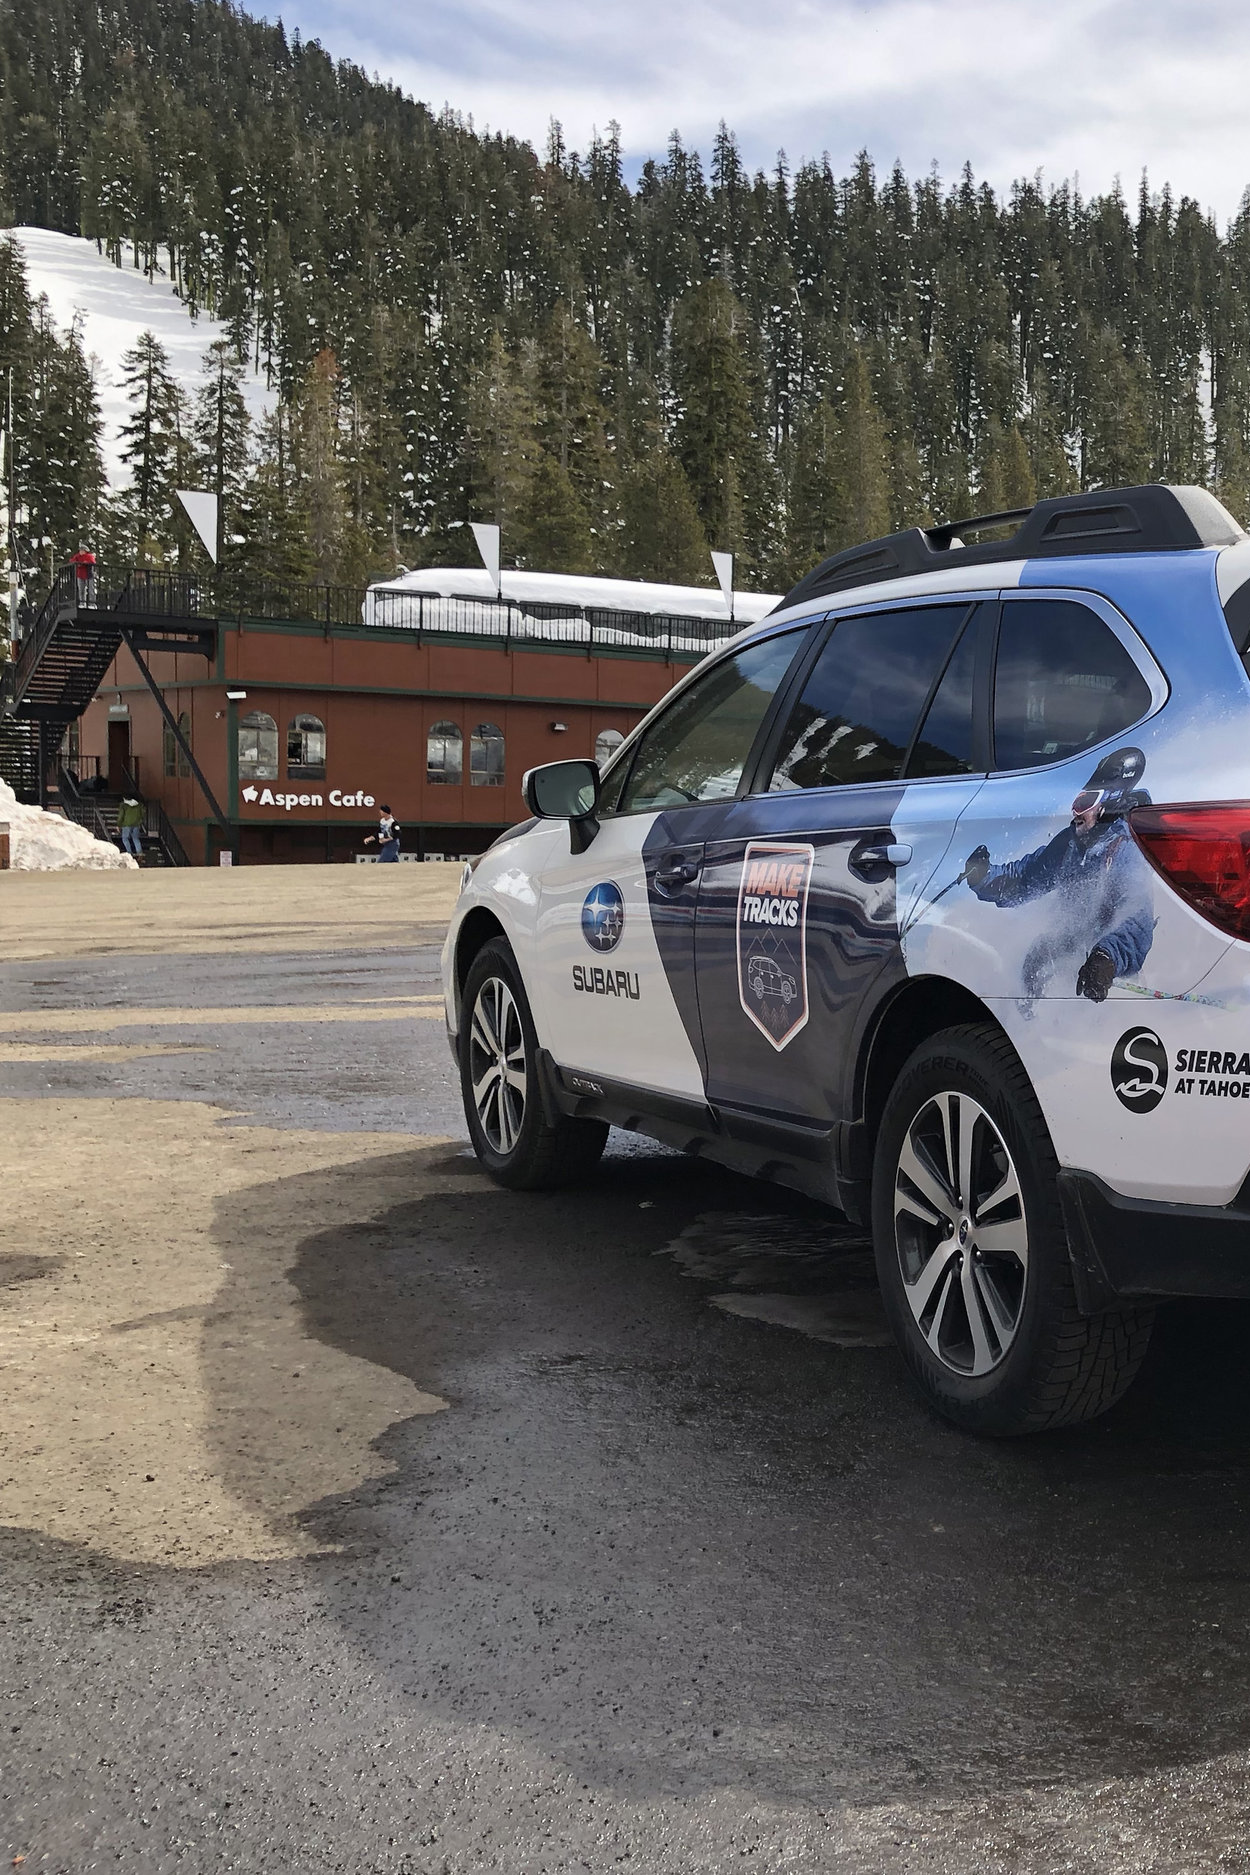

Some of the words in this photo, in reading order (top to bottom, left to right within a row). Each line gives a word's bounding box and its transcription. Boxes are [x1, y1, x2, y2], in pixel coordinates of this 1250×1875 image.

[259, 788, 323, 811] Aspen
[328, 790, 375, 807] Cafe
[746, 862, 805, 898] MAKE
[743, 896, 800, 927] TRACKS
[572, 965, 641, 1000] SUBARU
[1174, 1049, 1250, 1076] SIERRA
[1174, 1077, 1195, 1095] AT
[1198, 1079, 1250, 1099] TAHOE
